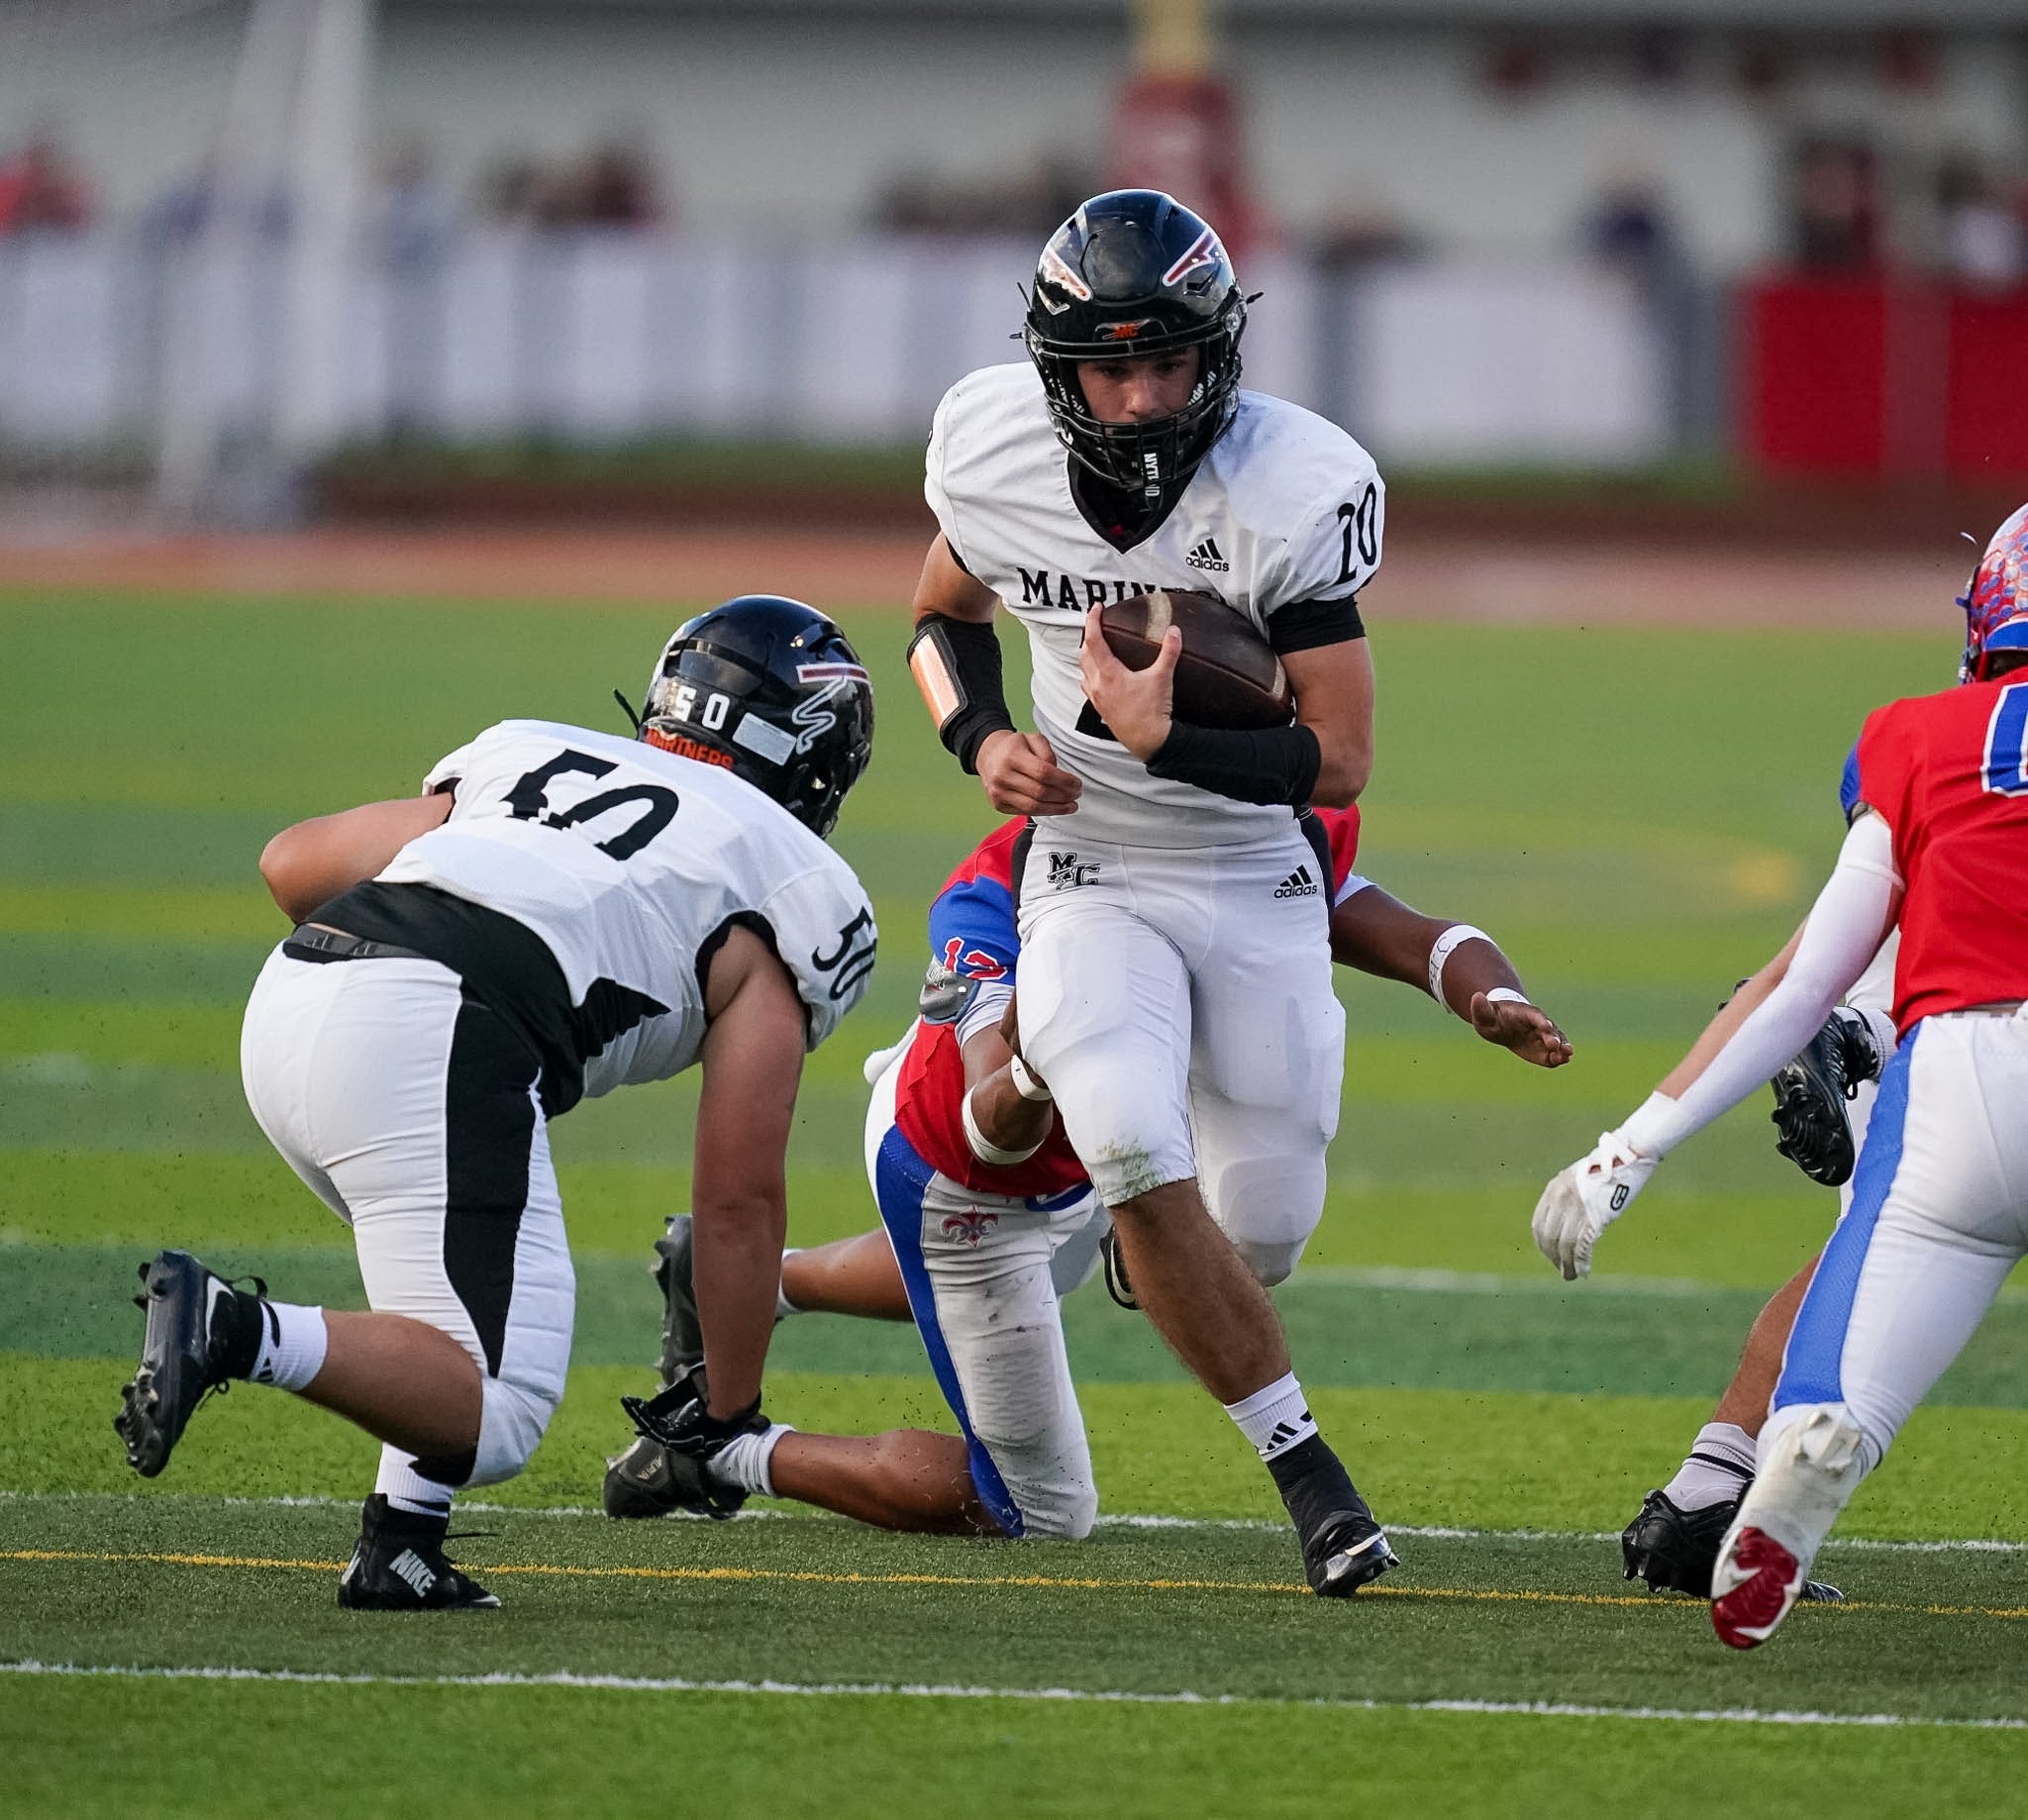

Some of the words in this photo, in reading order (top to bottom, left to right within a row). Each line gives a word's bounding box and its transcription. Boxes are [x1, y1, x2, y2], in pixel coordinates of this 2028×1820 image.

[1144, 453, 1161, 497] NYTLND
[1332, 481, 1377, 586] 20
[1185, 556, 1230, 572] adidas
[1017, 567, 1218, 613] MARI
[671, 683, 731, 732] 50
[1273, 882, 1318, 899] adidas
[811, 905, 878, 1001] 50
[388, 1548, 437, 1598] NIKE
